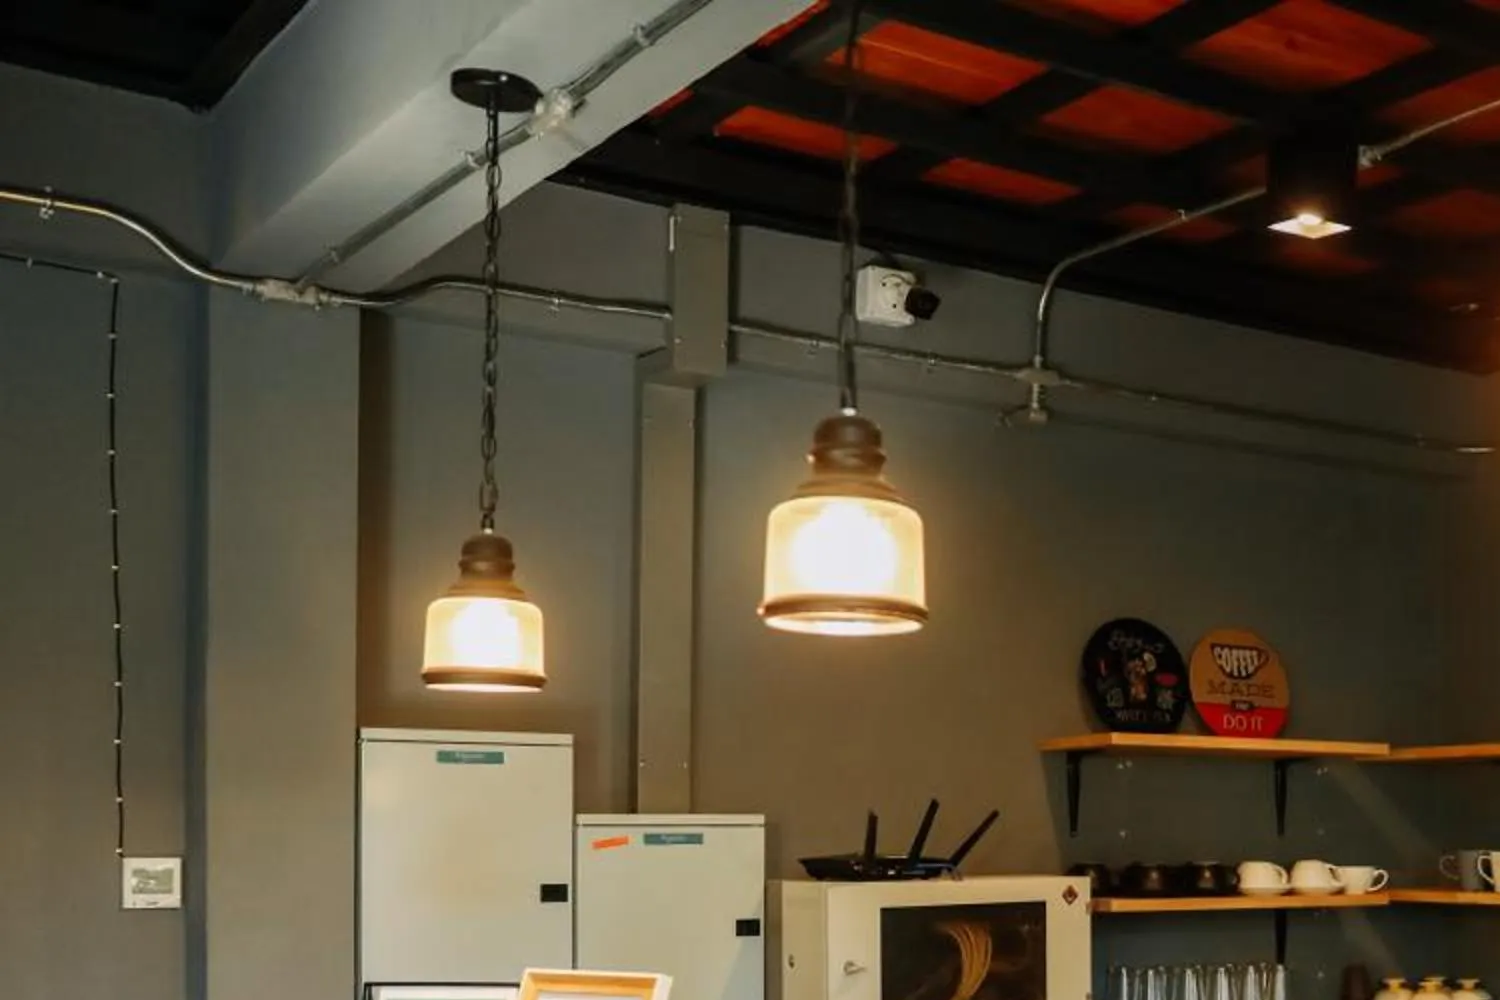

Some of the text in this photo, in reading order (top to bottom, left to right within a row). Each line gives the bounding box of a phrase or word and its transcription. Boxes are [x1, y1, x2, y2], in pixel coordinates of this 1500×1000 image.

[1213, 645, 1260, 677] COFFEE
[1206, 679, 1276, 699] MADE
[1222, 713, 1265, 732] DO IT
